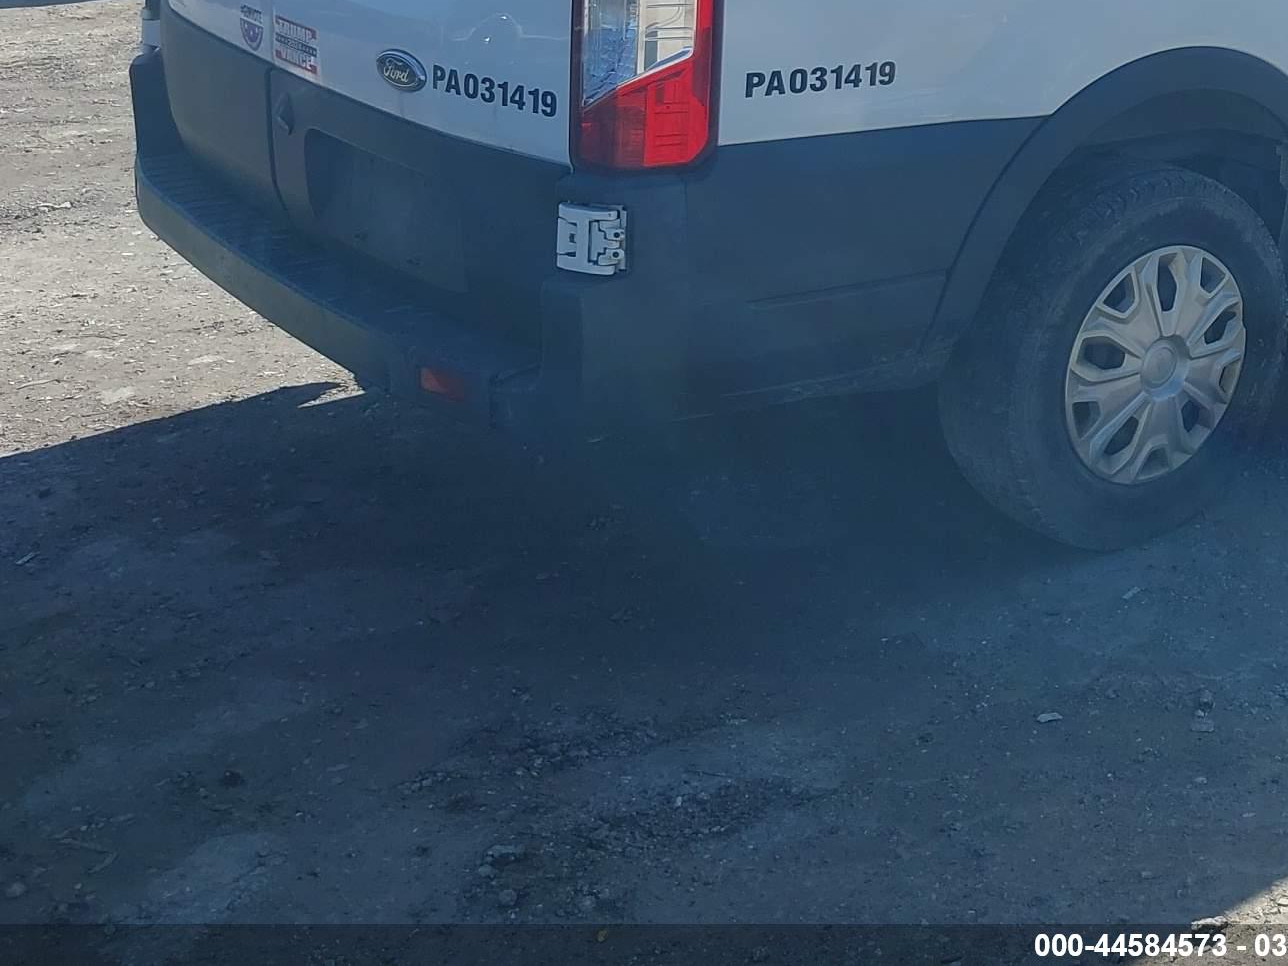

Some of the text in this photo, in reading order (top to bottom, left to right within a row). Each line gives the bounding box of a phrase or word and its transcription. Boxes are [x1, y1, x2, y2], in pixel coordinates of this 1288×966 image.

[383, 57, 410, 84] Ford
[744, 60, 897, 99] PA031419
[432, 63, 558, 118] PA031419
